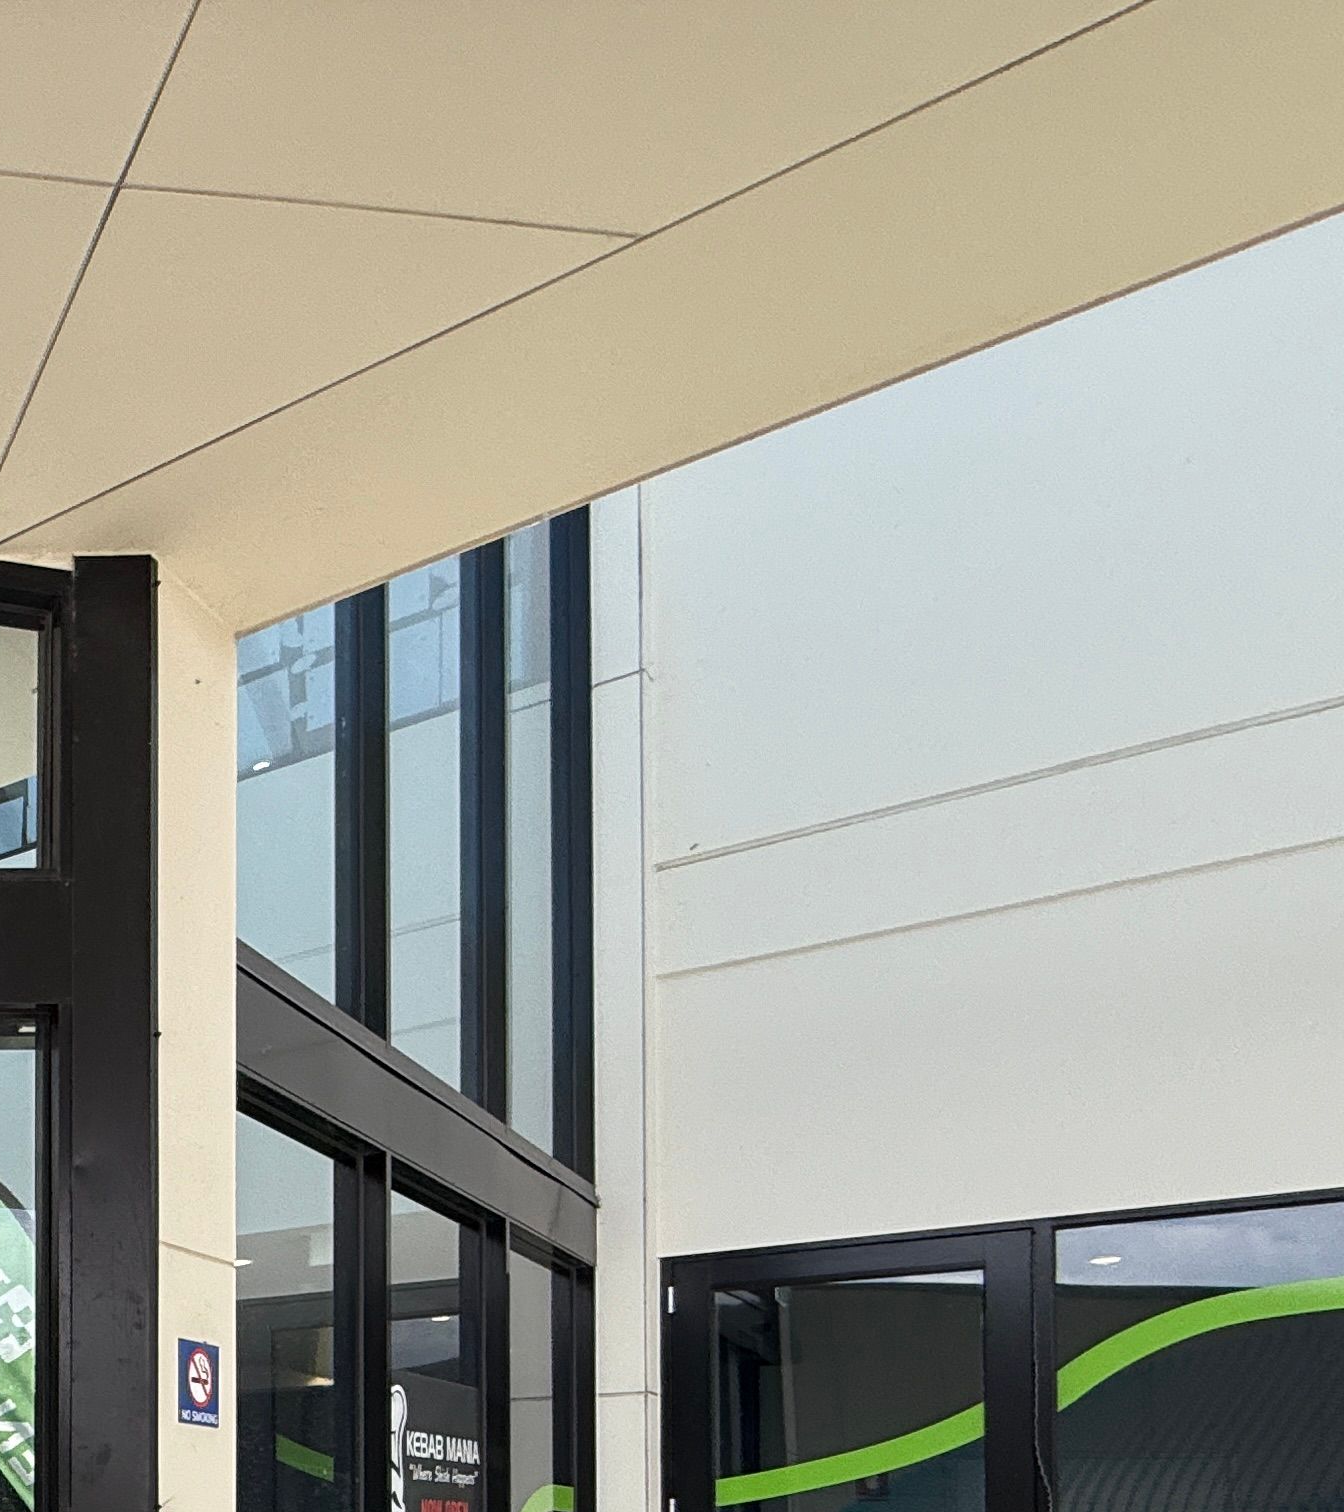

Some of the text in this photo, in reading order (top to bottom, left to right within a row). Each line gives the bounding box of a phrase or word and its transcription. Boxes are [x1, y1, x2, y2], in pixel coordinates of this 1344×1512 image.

[181, 1409, 191, 1420] NO
[406, 1430, 480, 1465] KEBAB MANIA
